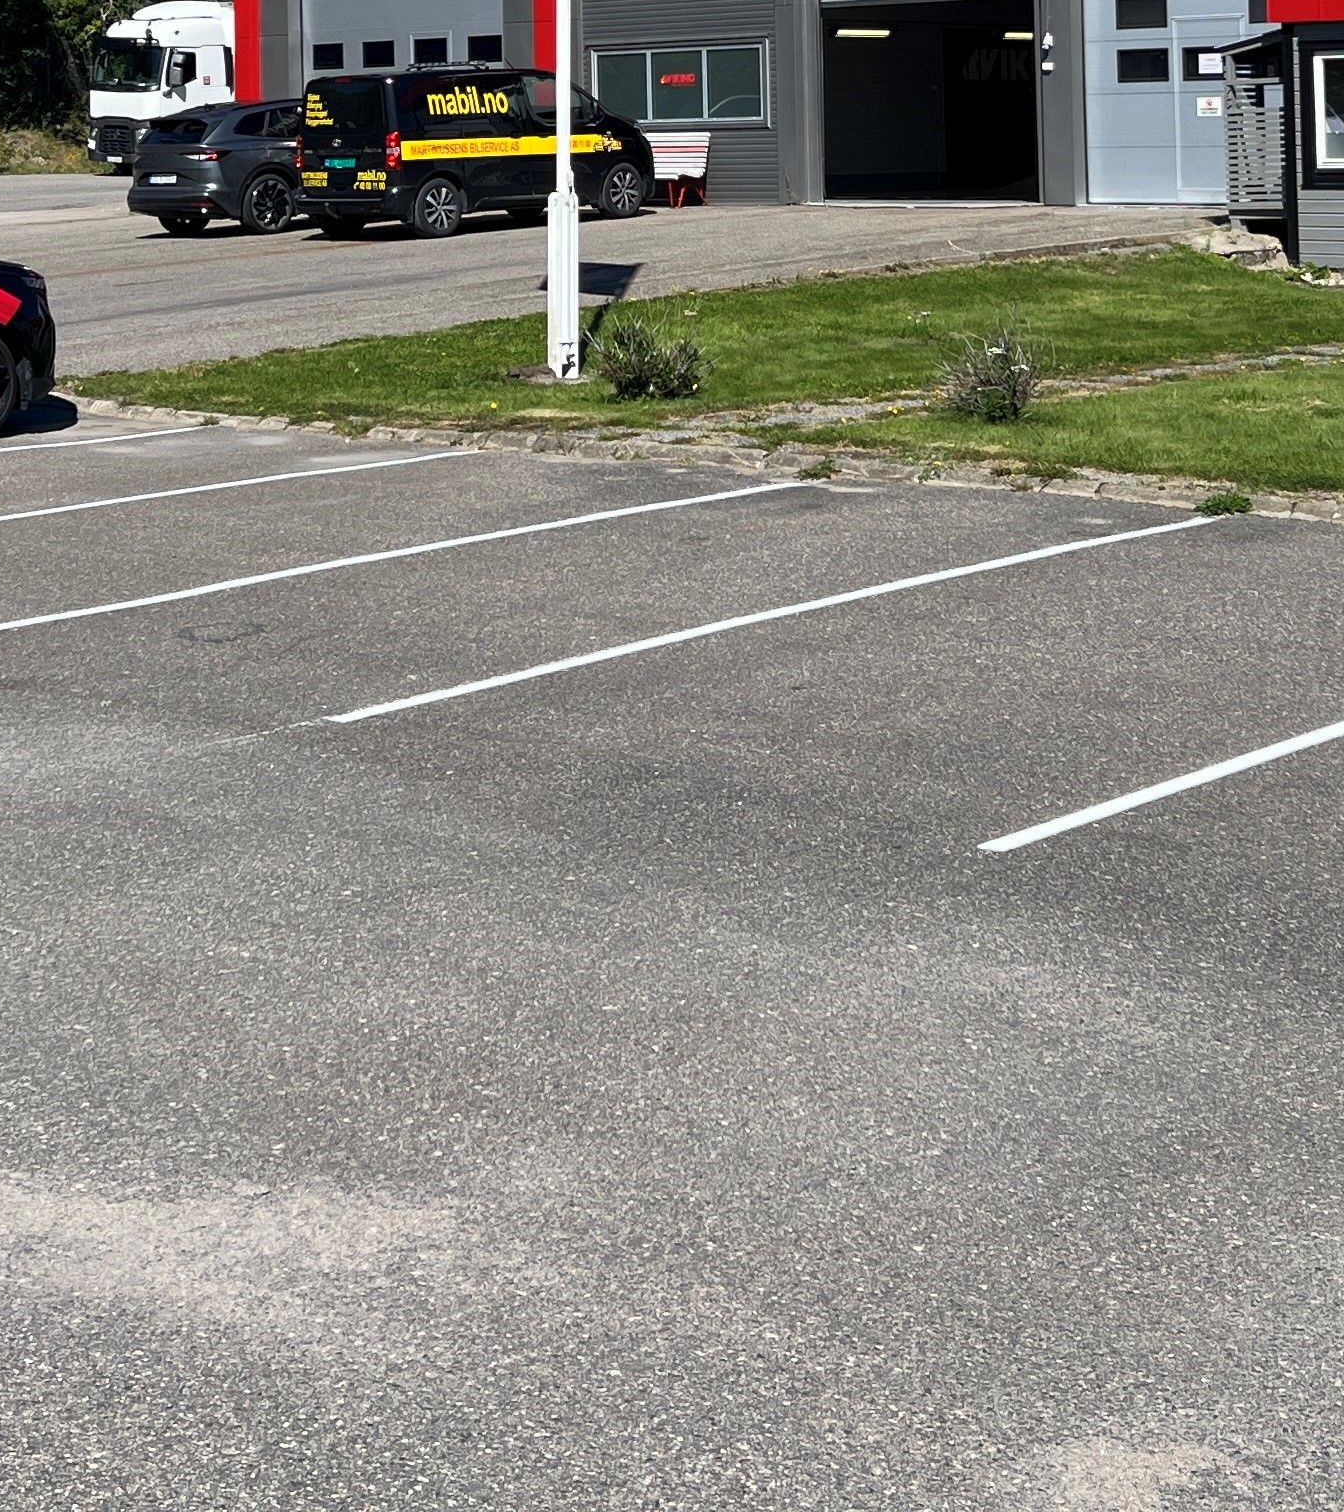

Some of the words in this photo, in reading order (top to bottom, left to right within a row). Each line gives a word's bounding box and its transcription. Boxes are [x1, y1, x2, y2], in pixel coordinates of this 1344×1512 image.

[979, 49, 1033, 81] VIK
[427, 86, 509, 115] mabil.no
[511, 141, 520, 152] AS
[357, 169, 386, 181] mabil.no
